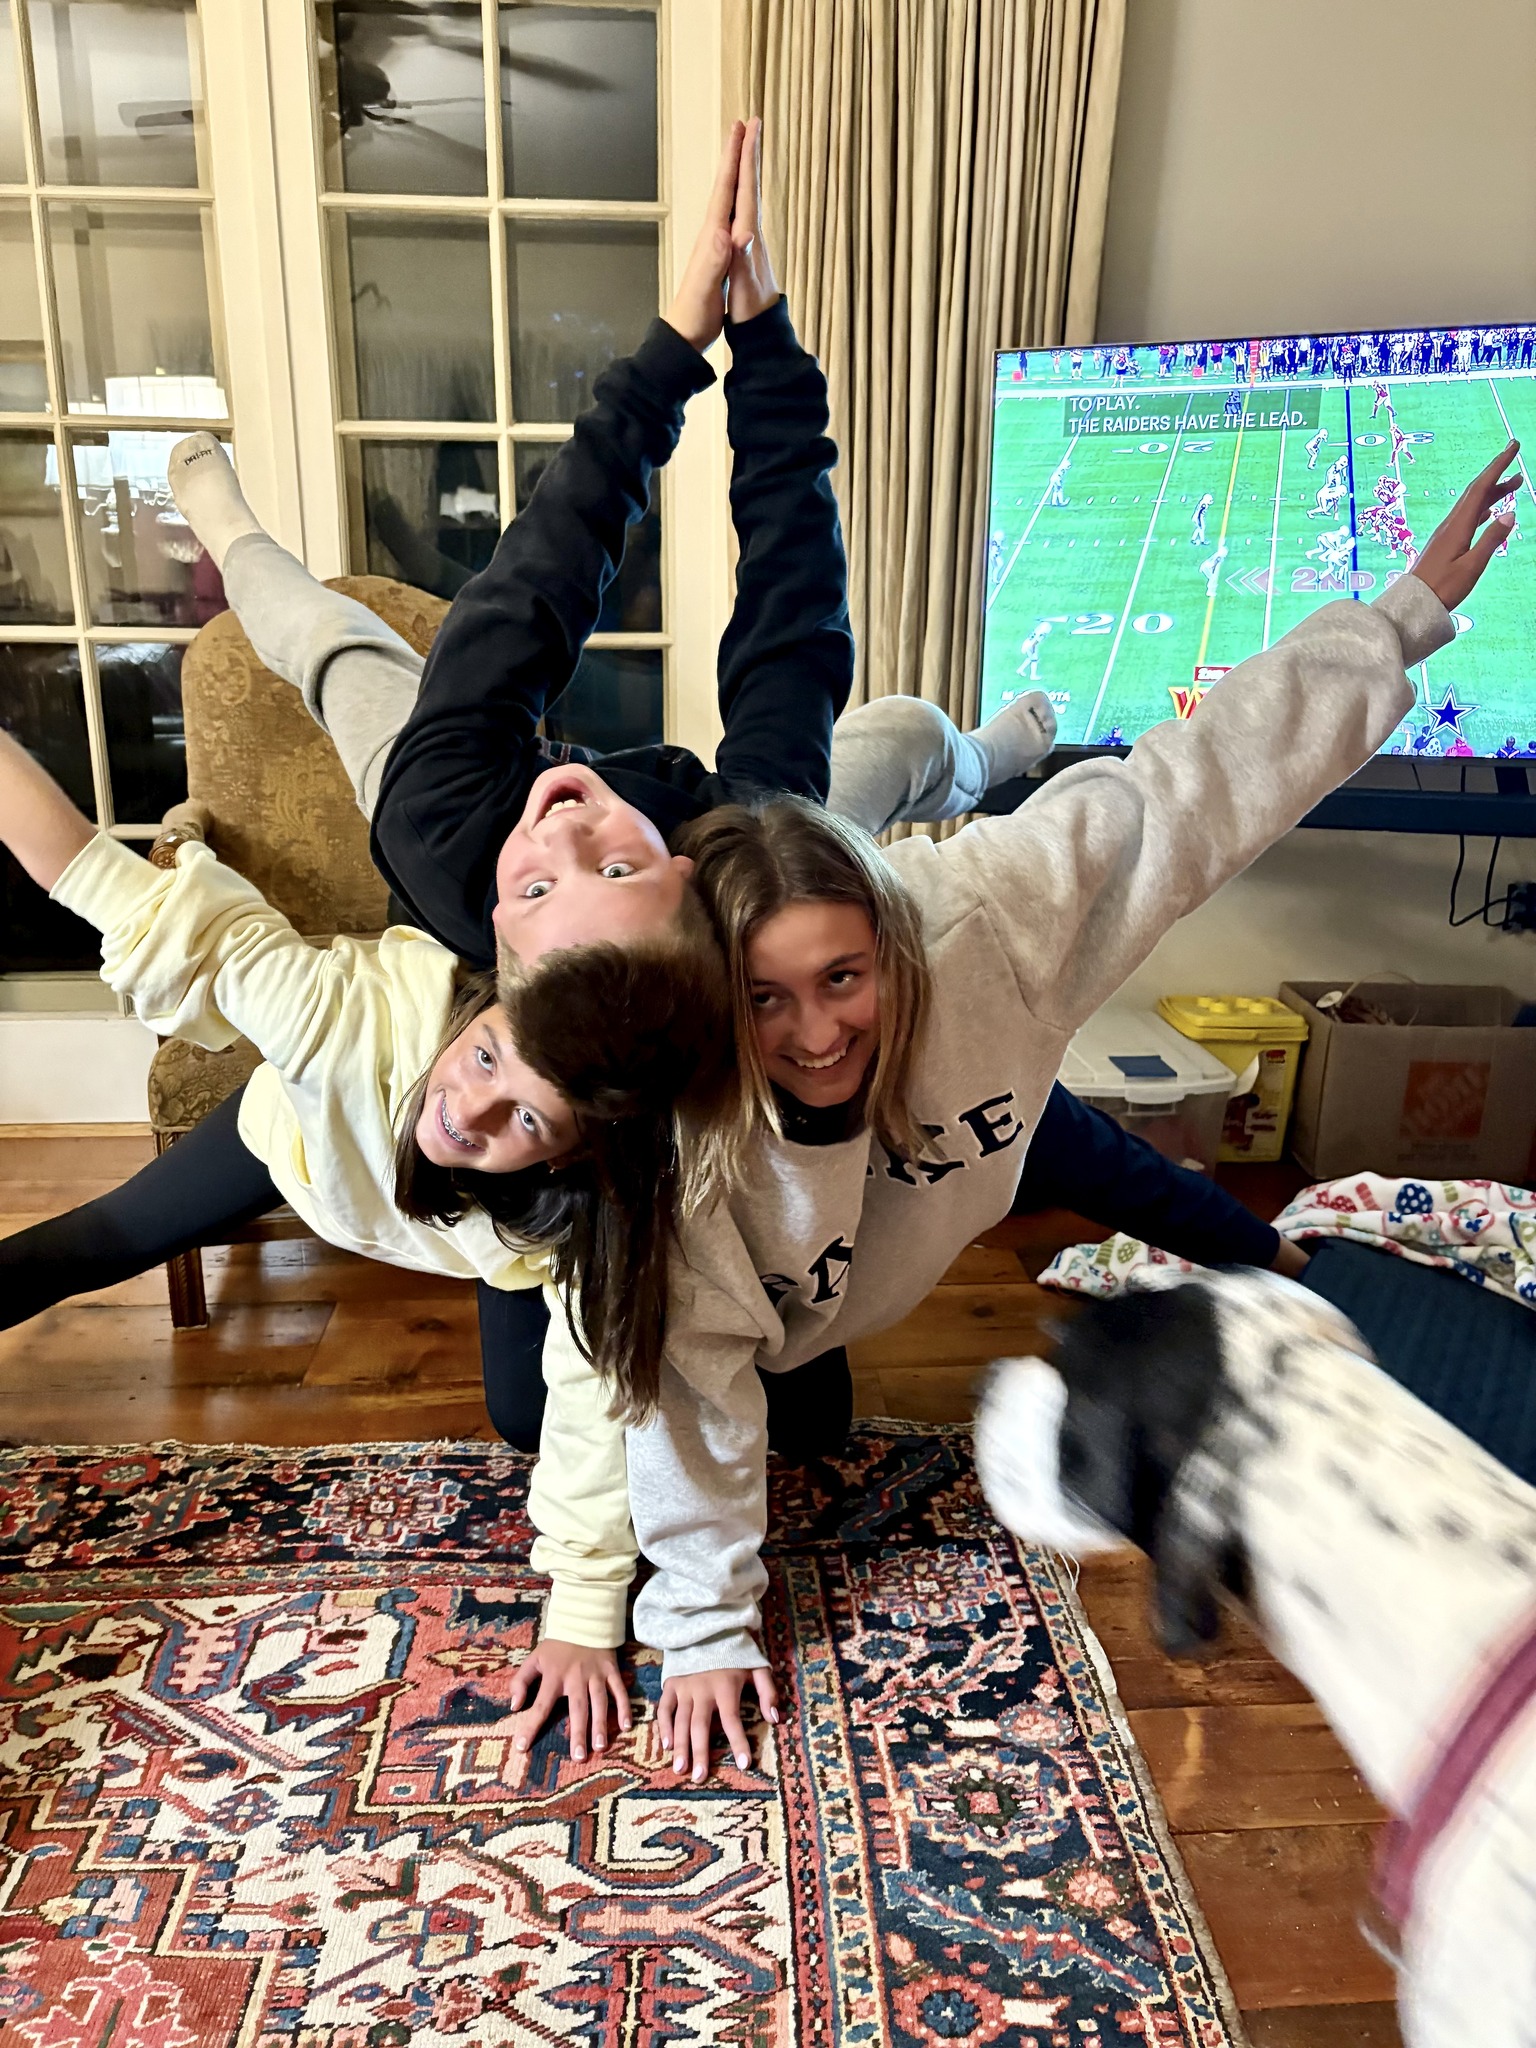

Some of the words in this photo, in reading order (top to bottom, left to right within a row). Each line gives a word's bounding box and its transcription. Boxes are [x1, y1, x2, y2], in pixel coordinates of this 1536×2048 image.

[1070, 397, 1093, 412] TO
[1096, 396, 1141, 411] PLAY.
[1069, 418, 1100, 433] THE
[1103, 416, 1170, 432] RAIDERS
[1175, 414, 1220, 430] HAVE
[1224, 412, 1257, 428] THE
[1259, 411, 1308, 427] LEAD.
[1291, 567, 1376, 592] 2ND
